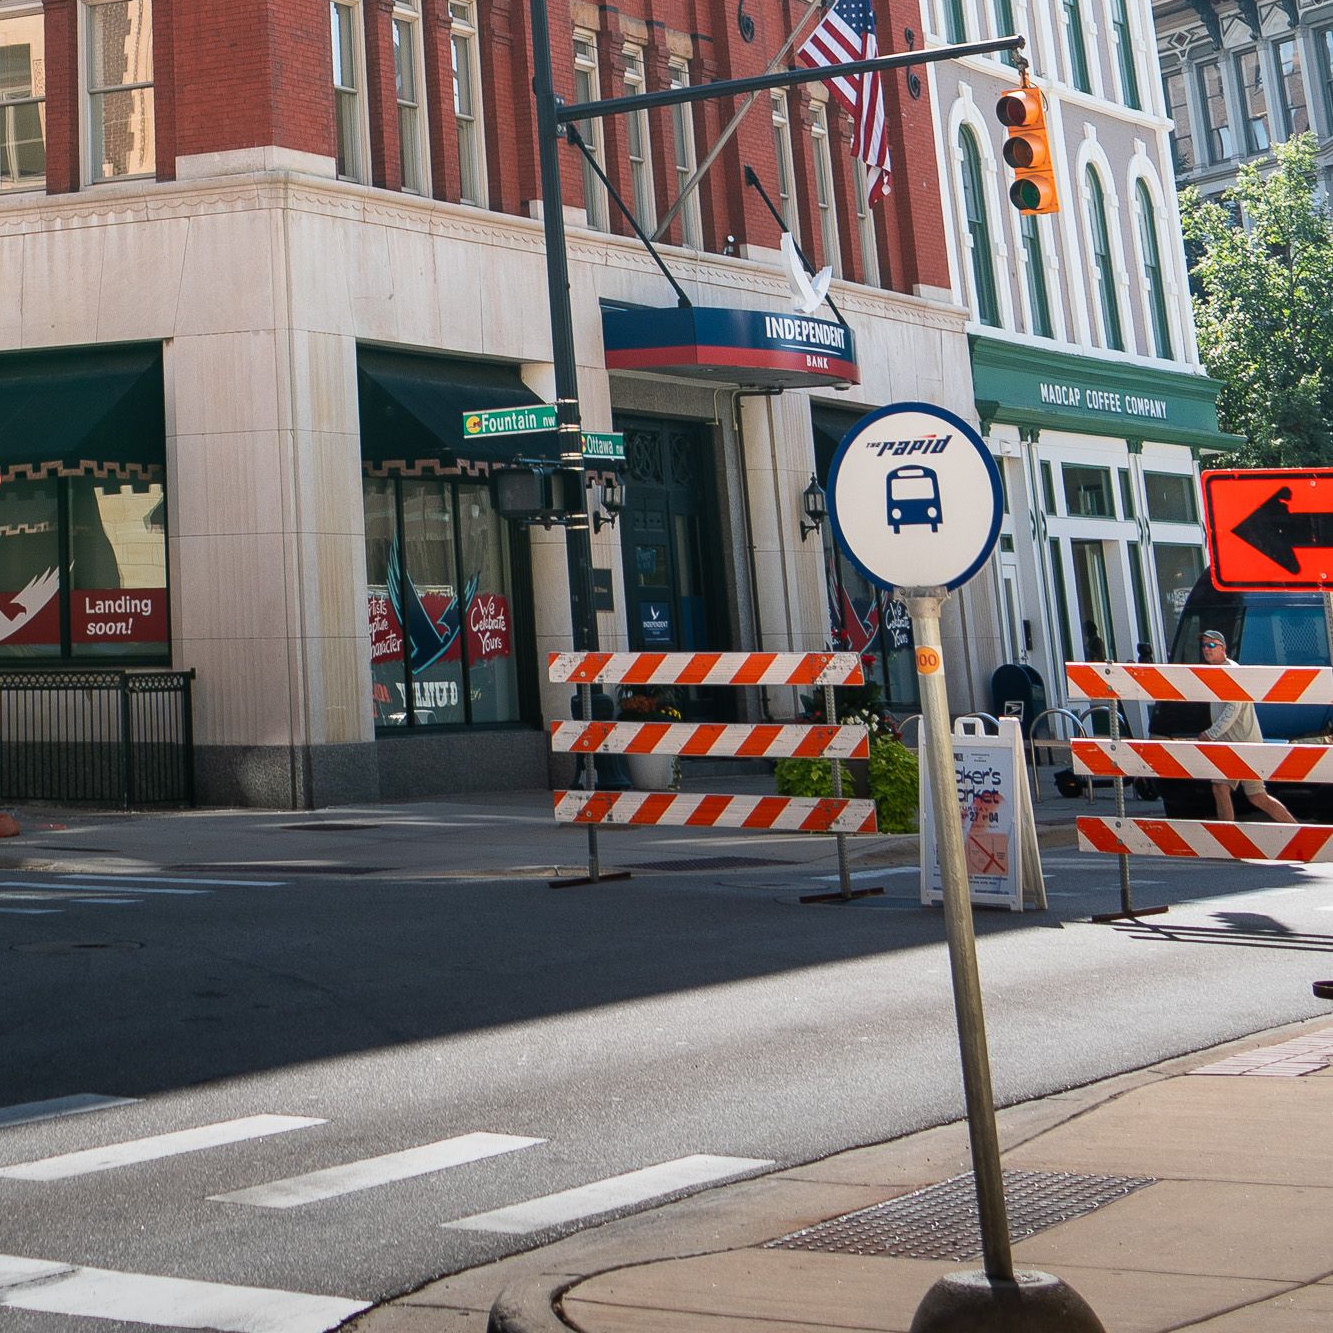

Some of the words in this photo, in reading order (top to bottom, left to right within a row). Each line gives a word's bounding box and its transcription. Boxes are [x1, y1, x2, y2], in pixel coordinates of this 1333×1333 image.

[765, 316, 845, 350] INDEPENDENT
[806, 354, 829, 369] BANK
[1040, 383, 1081, 407] MADCAP
[1086, 389, 1122, 413] COFFEE
[1125, 395, 1166, 419] COMPANY
[481, 410, 537, 433] Fountain
[586, 434, 614, 455] Ottawa
[85, 595, 152, 616] Landing
[367, 595, 388, 619] rtists
[477, 596, 495, 616] We
[86, 617, 134, 635] soon!
[470, 607, 507, 632] Celebrate
[370, 630, 403, 660] haracter
[478, 631, 503, 655] Yours
[954, 766, 1002, 786] aker's
[957, 785, 1000, 803] arket
